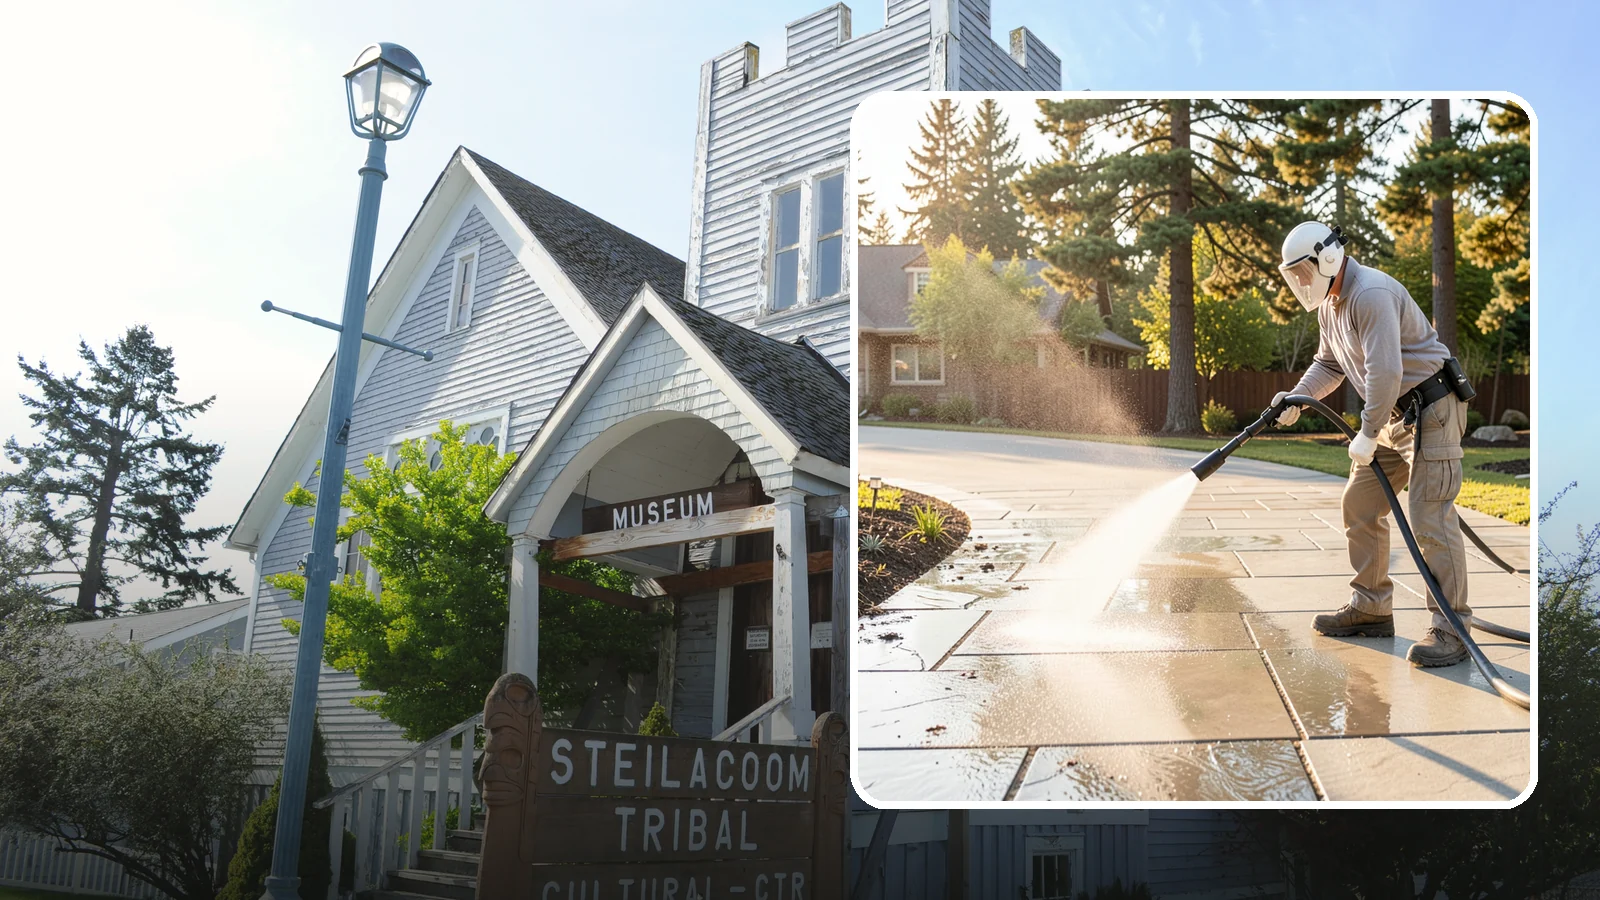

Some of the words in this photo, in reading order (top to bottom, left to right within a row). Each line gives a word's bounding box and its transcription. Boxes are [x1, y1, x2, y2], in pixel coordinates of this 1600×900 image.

[613, 491, 713, 531] MUSEUM
[550, 738, 809, 792] STEILACOOM
[615, 806, 758, 852] TRIBAL
